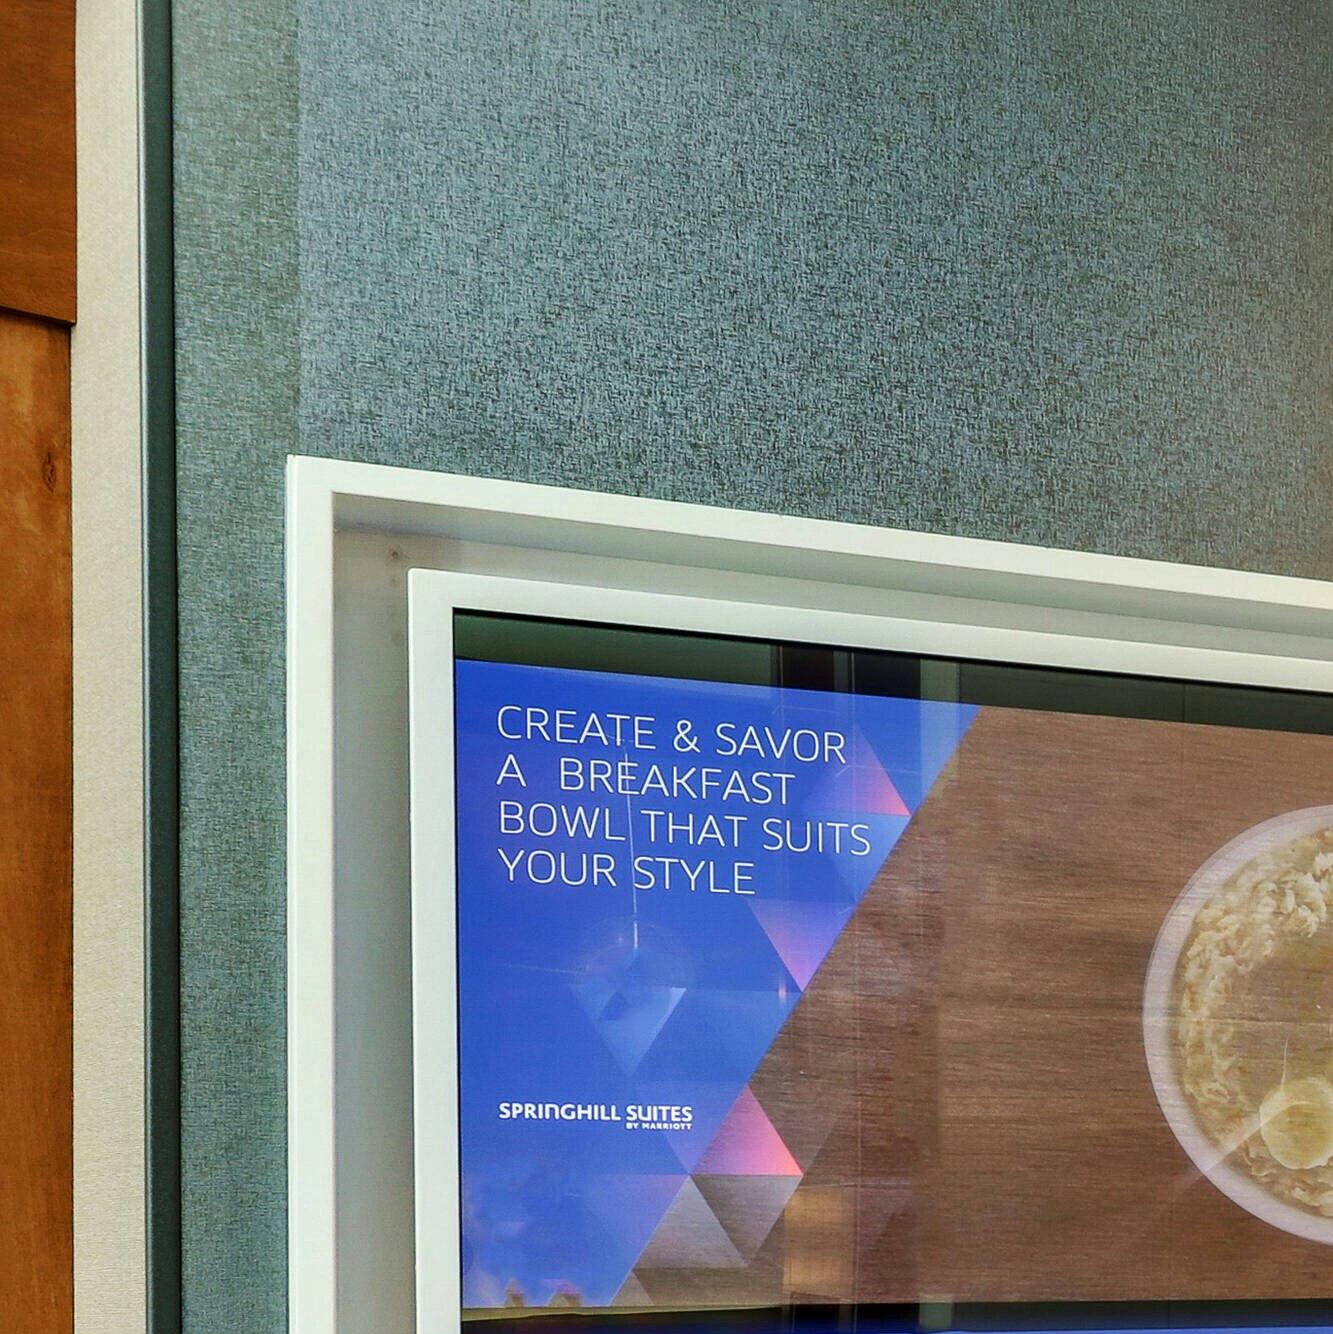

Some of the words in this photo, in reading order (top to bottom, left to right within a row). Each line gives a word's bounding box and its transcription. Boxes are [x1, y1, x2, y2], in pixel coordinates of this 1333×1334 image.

[497, 704, 657, 751] CREATE
[672, 719, 701, 754] &
[715, 722, 847, 766] SAVOR
[496, 753, 527, 788] A
[560, 757, 796, 806] BREAKFAST
[500, 800, 626, 842] BOWL
[640, 810, 748, 848] THAT
[762, 818, 872, 857] SUITS
[497, 848, 617, 888] YOUR
[634, 857, 756, 896] STYLE
[499, 1102, 622, 1122] SPRINGHILL
[626, 1105, 693, 1122] SUITES
[626, 1122, 639, 1130] BY
[642, 1122, 693, 1131] MARRIOTT
